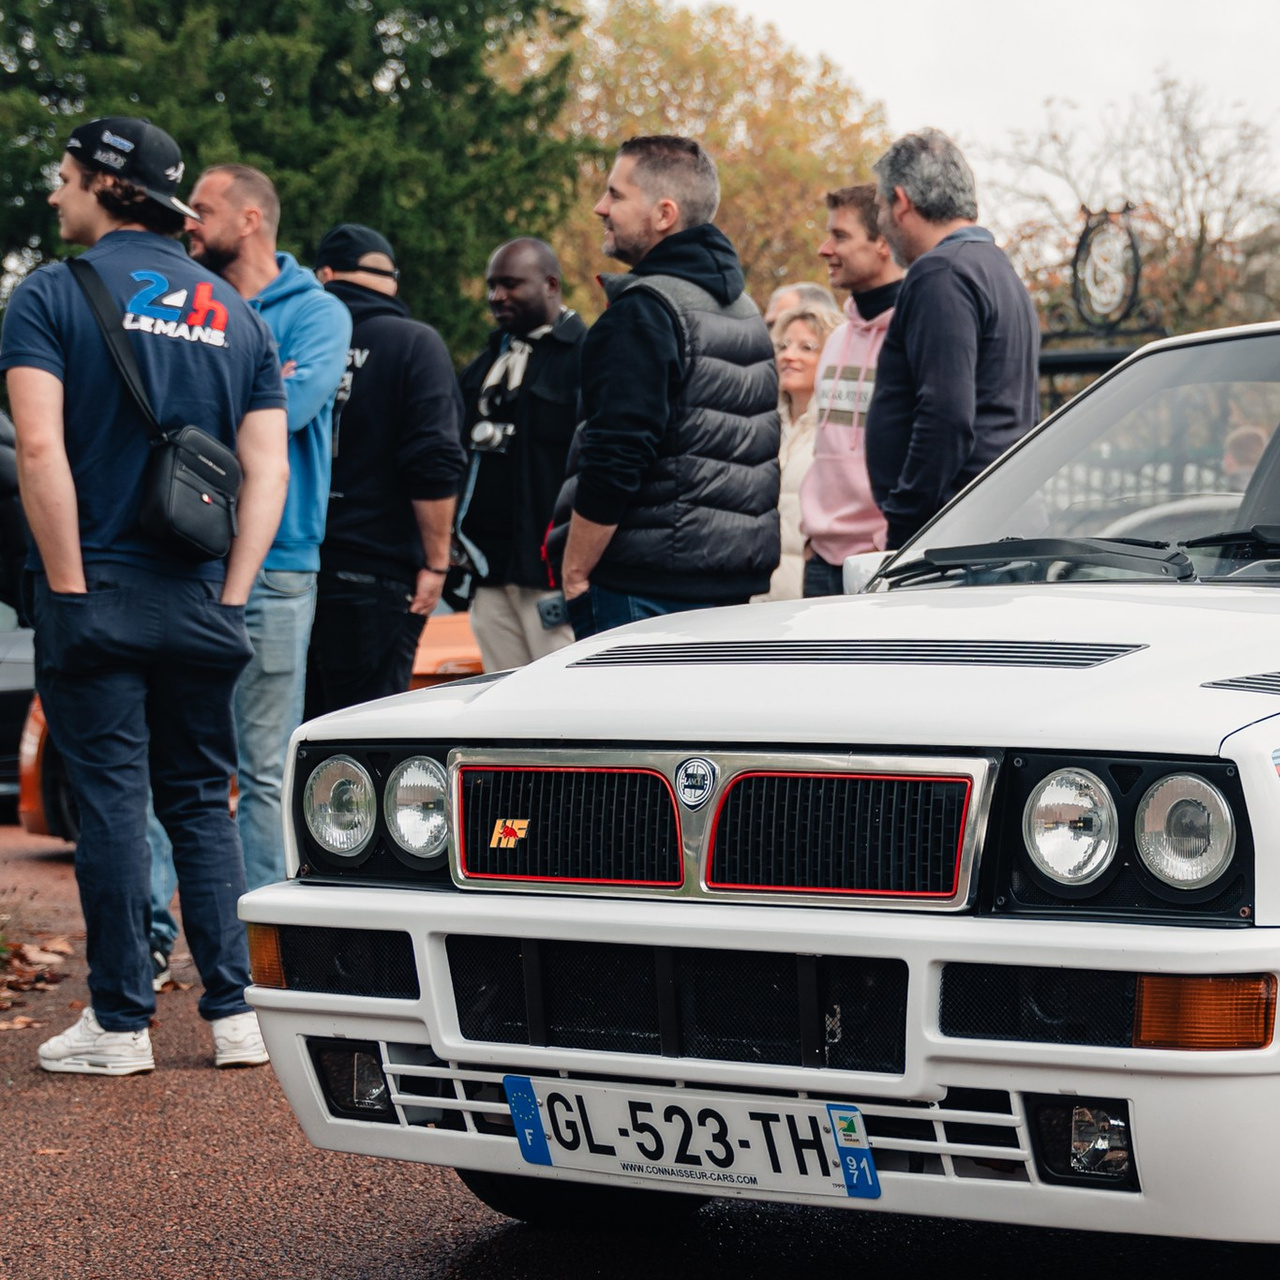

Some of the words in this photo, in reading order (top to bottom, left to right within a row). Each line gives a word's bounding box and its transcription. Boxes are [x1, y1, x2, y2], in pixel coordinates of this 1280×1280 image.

[523, 1128, 535, 1147] F
[546, 1091, 831, 1177] GL-523-TH
[620, 1162, 759, 1186] WWW.CONNAISSEUR-CARS.COM
